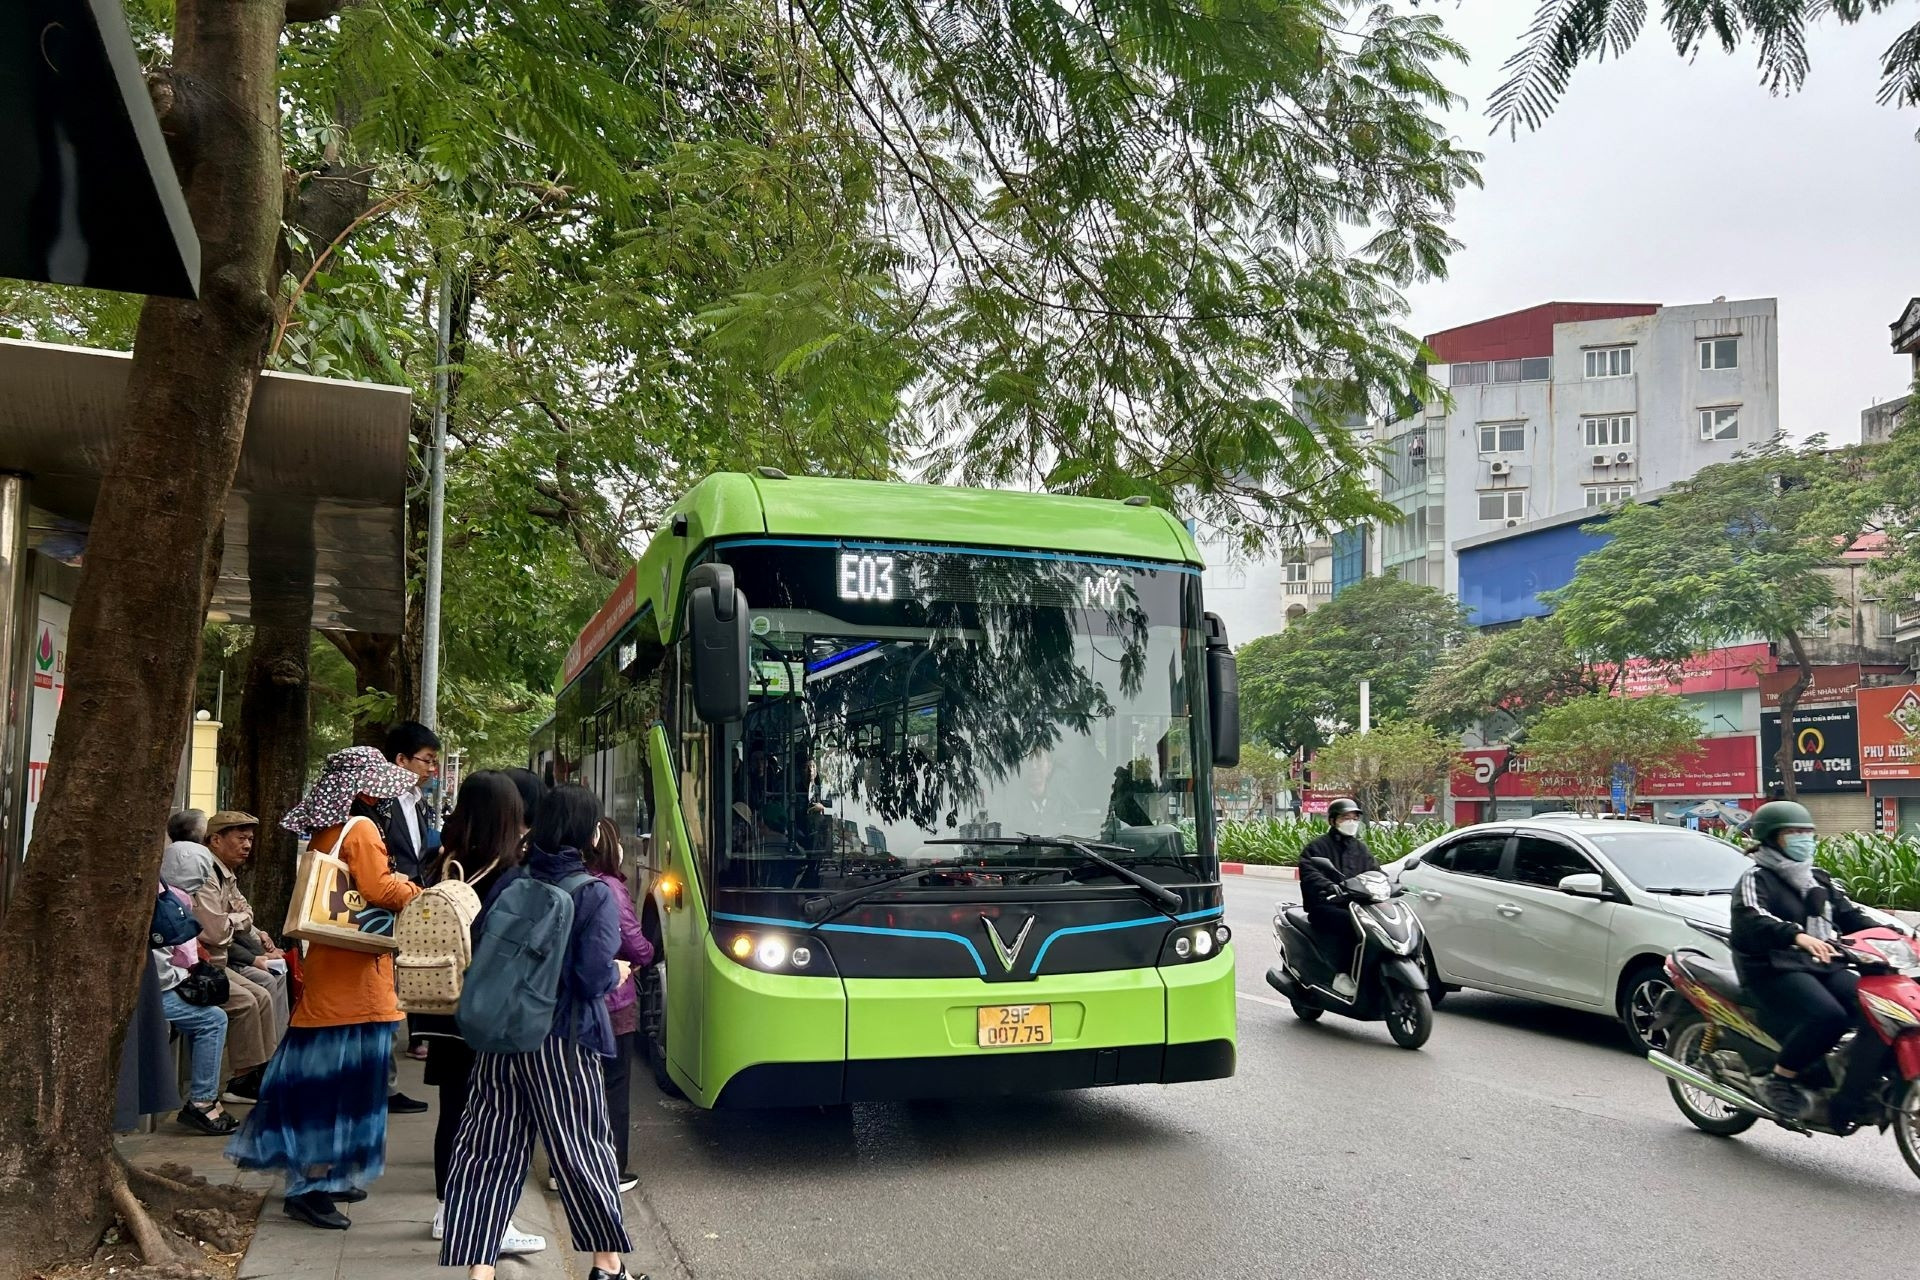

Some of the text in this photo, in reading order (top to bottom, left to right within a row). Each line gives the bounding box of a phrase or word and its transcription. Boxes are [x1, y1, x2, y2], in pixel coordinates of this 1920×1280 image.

[840, 554, 1121, 606] E03 MỸ
[1863, 745, 1884, 761] PHỤ
[348, 893, 361, 905] M
[1000, 1007, 1030, 1025] 29F
[988, 1025, 1044, 1045] 007.75
